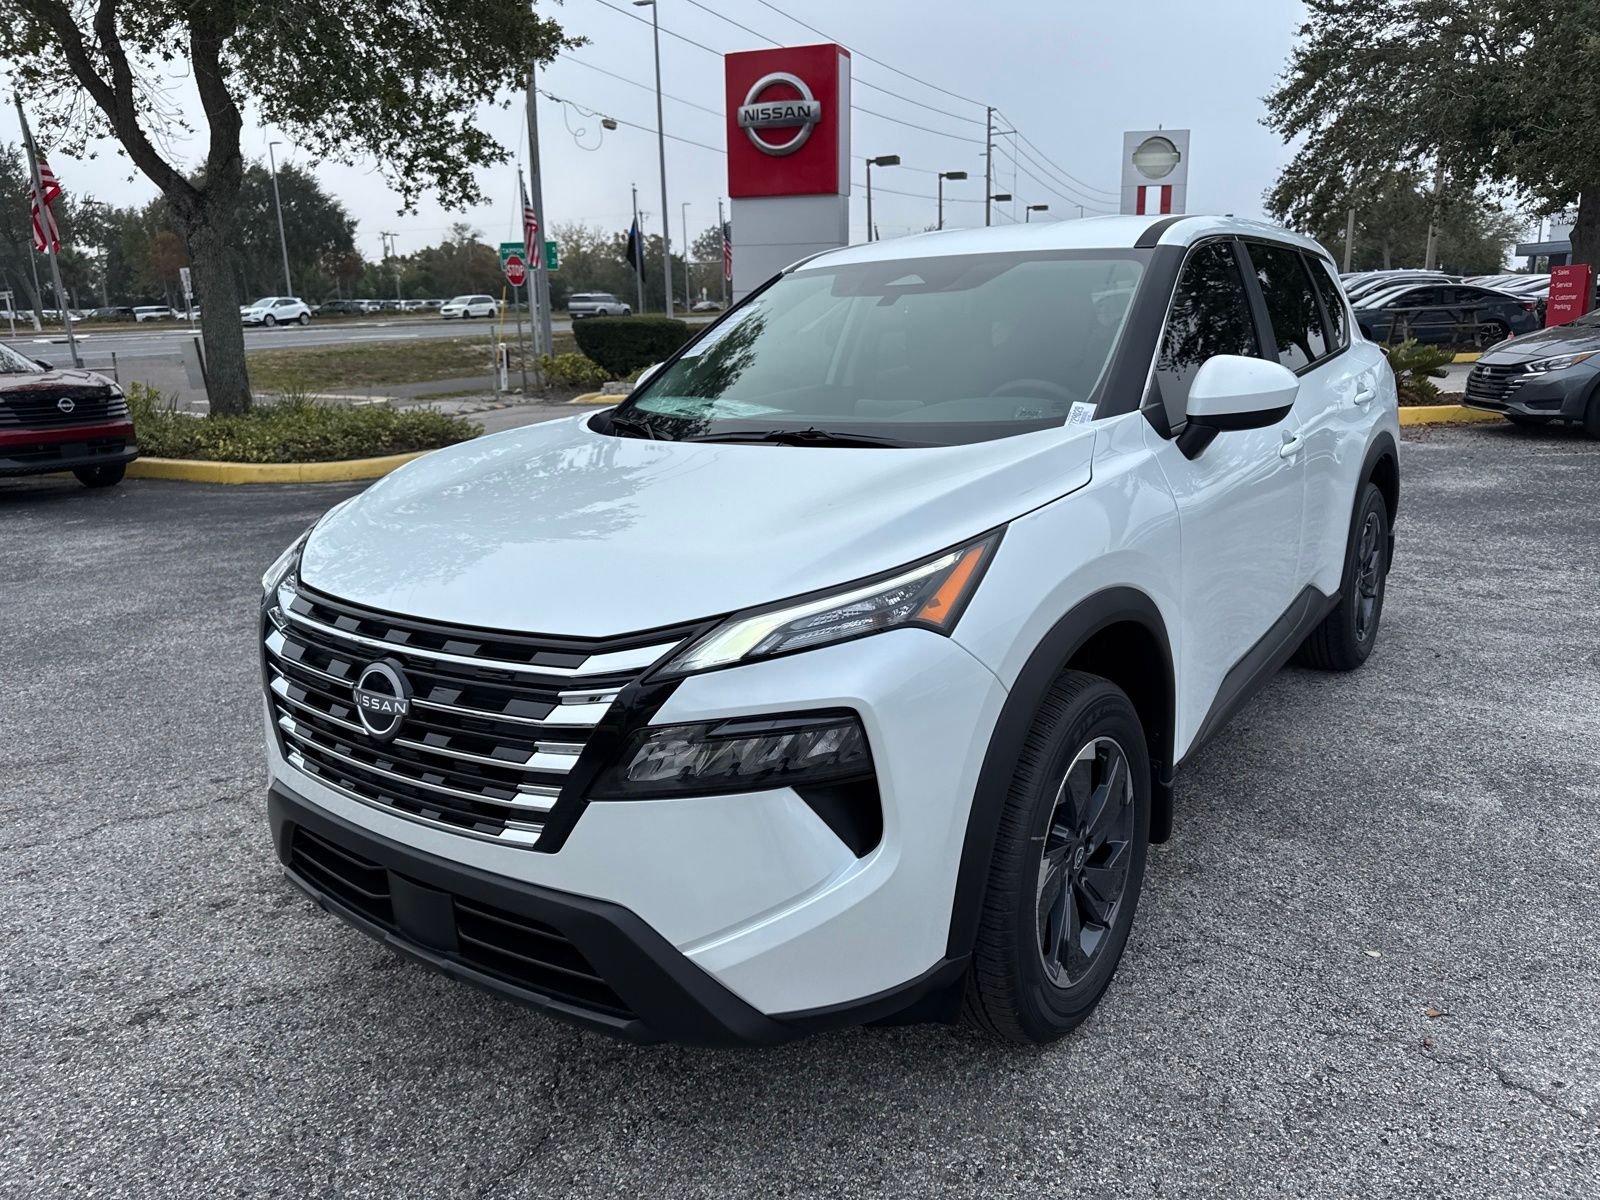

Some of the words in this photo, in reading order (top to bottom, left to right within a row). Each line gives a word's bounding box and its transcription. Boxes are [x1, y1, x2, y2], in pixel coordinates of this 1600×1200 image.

[744, 105, 811, 122] NISSAN
[507, 264, 524, 276] STOP
[353, 689, 406, 713] NISSAN
